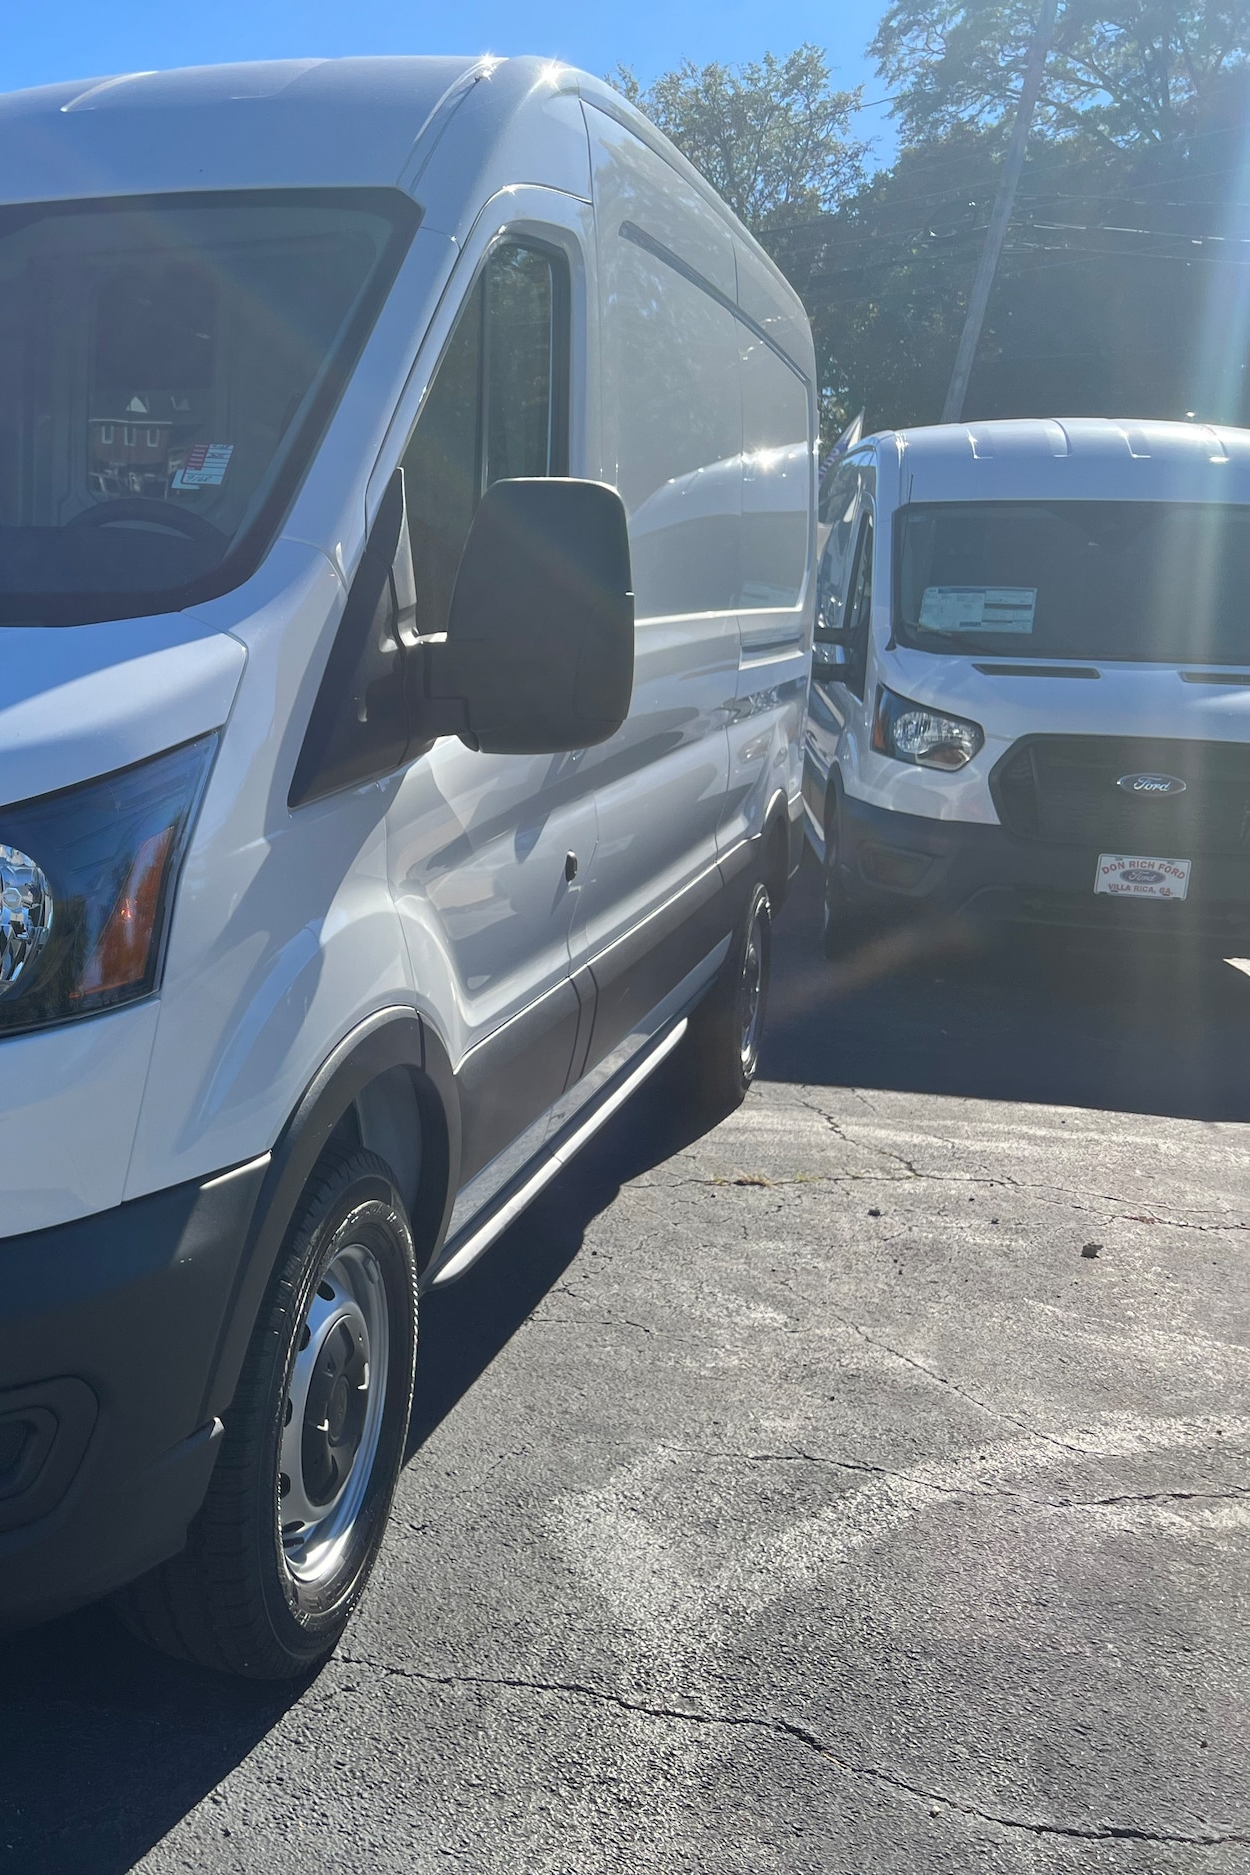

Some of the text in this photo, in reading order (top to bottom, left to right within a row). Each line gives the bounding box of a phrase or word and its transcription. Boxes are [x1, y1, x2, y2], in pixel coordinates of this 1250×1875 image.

[1133, 776, 1171, 792] Ford
[1101, 860, 1186, 880] DON RICH FORD
[1128, 870, 1157, 881] Ford
[1108, 883, 1131, 891] VILLA
